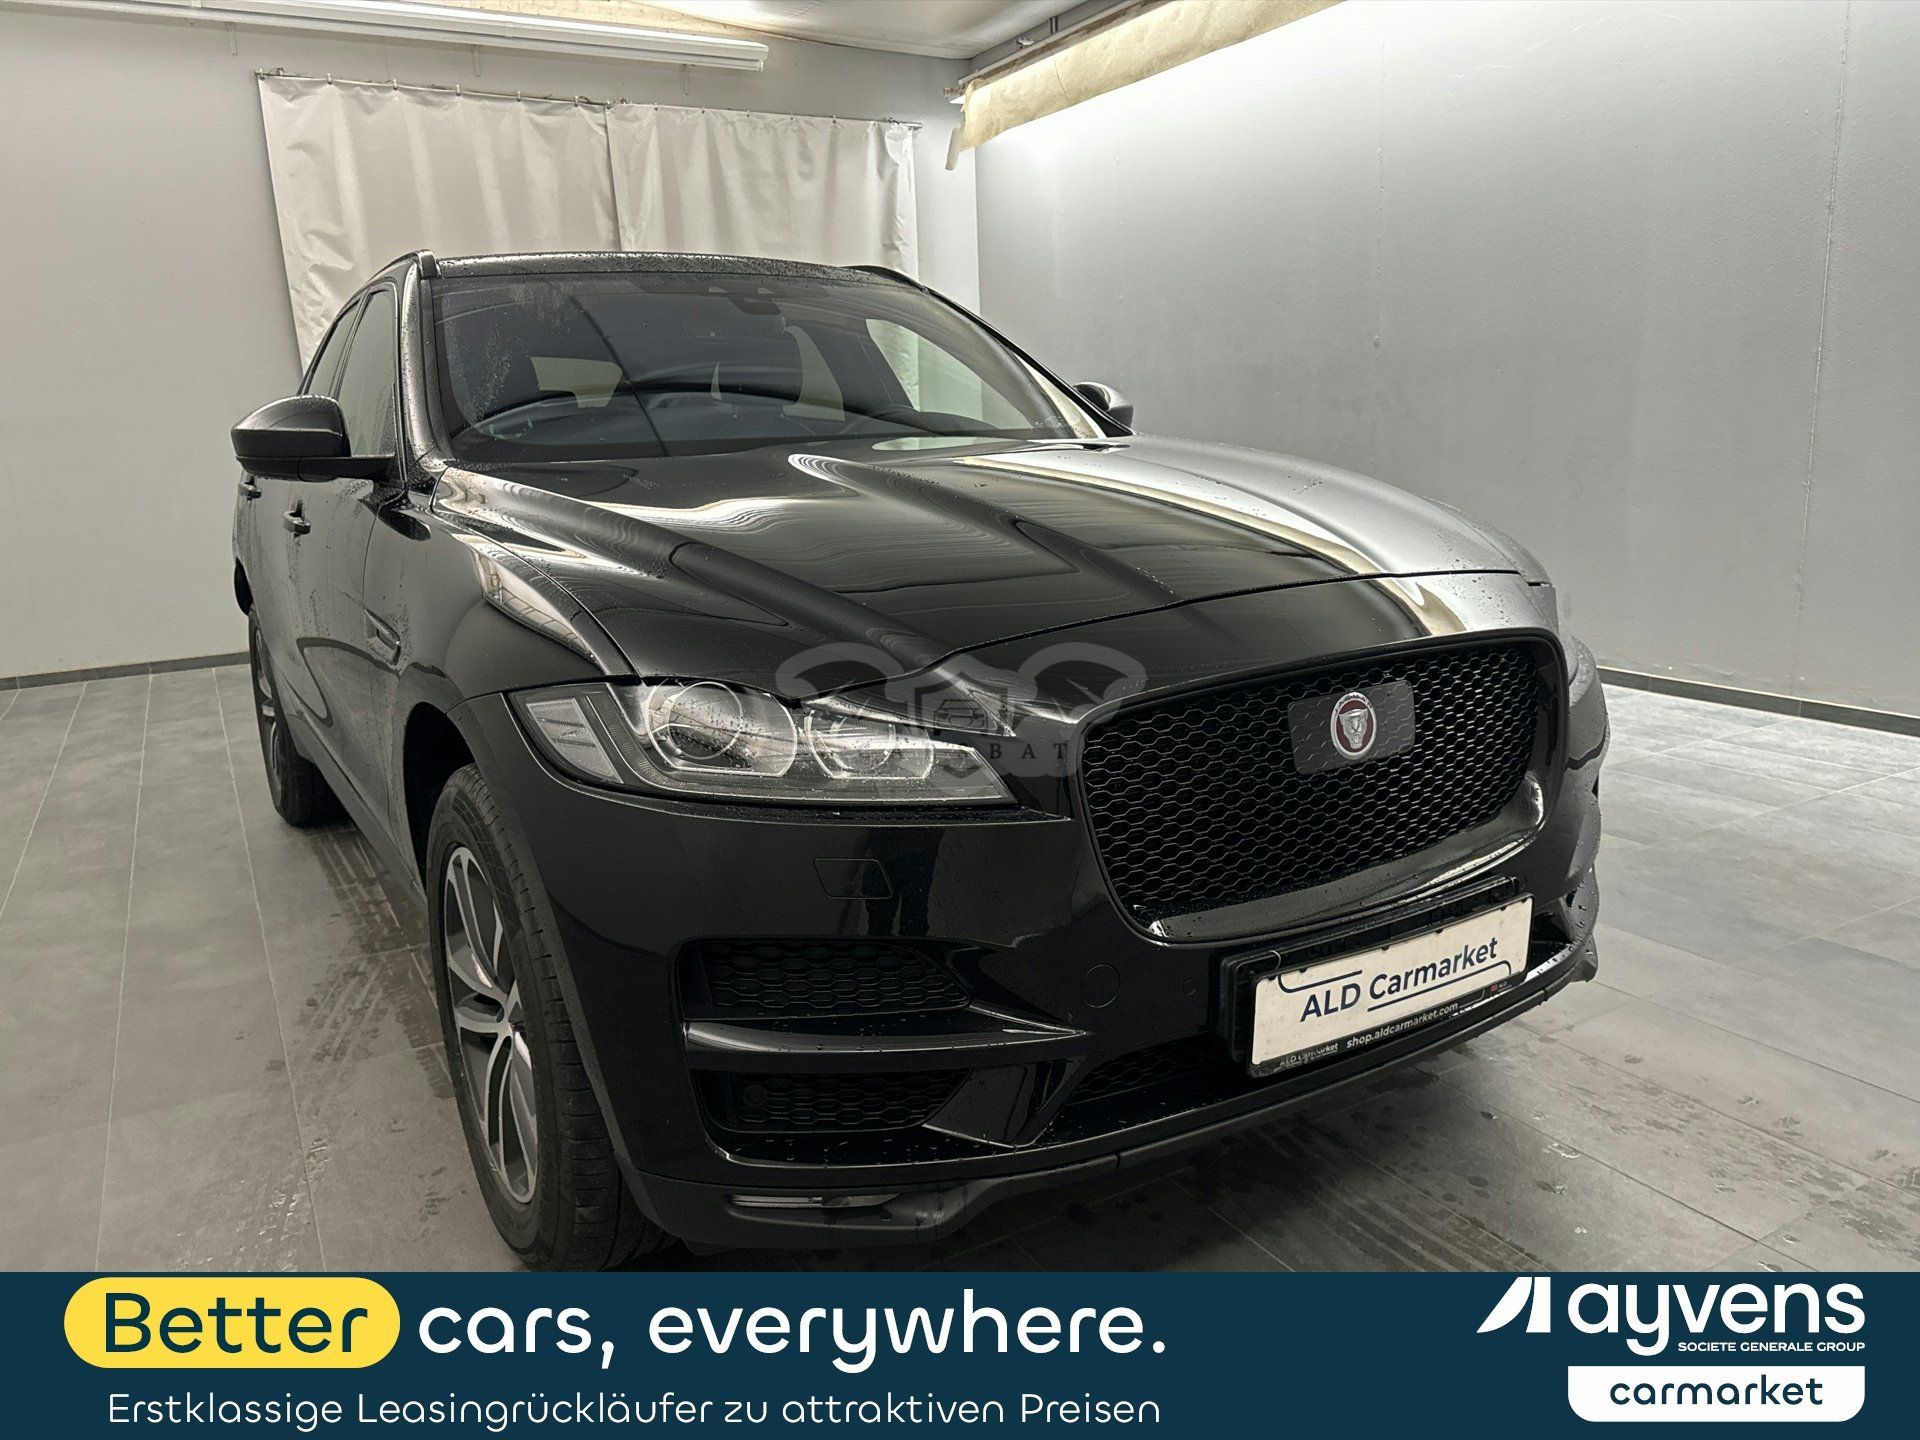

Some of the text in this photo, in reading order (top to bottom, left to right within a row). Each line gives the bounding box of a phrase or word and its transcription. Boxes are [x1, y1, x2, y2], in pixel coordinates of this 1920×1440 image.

[1300, 937, 1498, 1022] ALD Carmarket
[1346, 1002, 1458, 1049] shop.aldcarmarket.com
